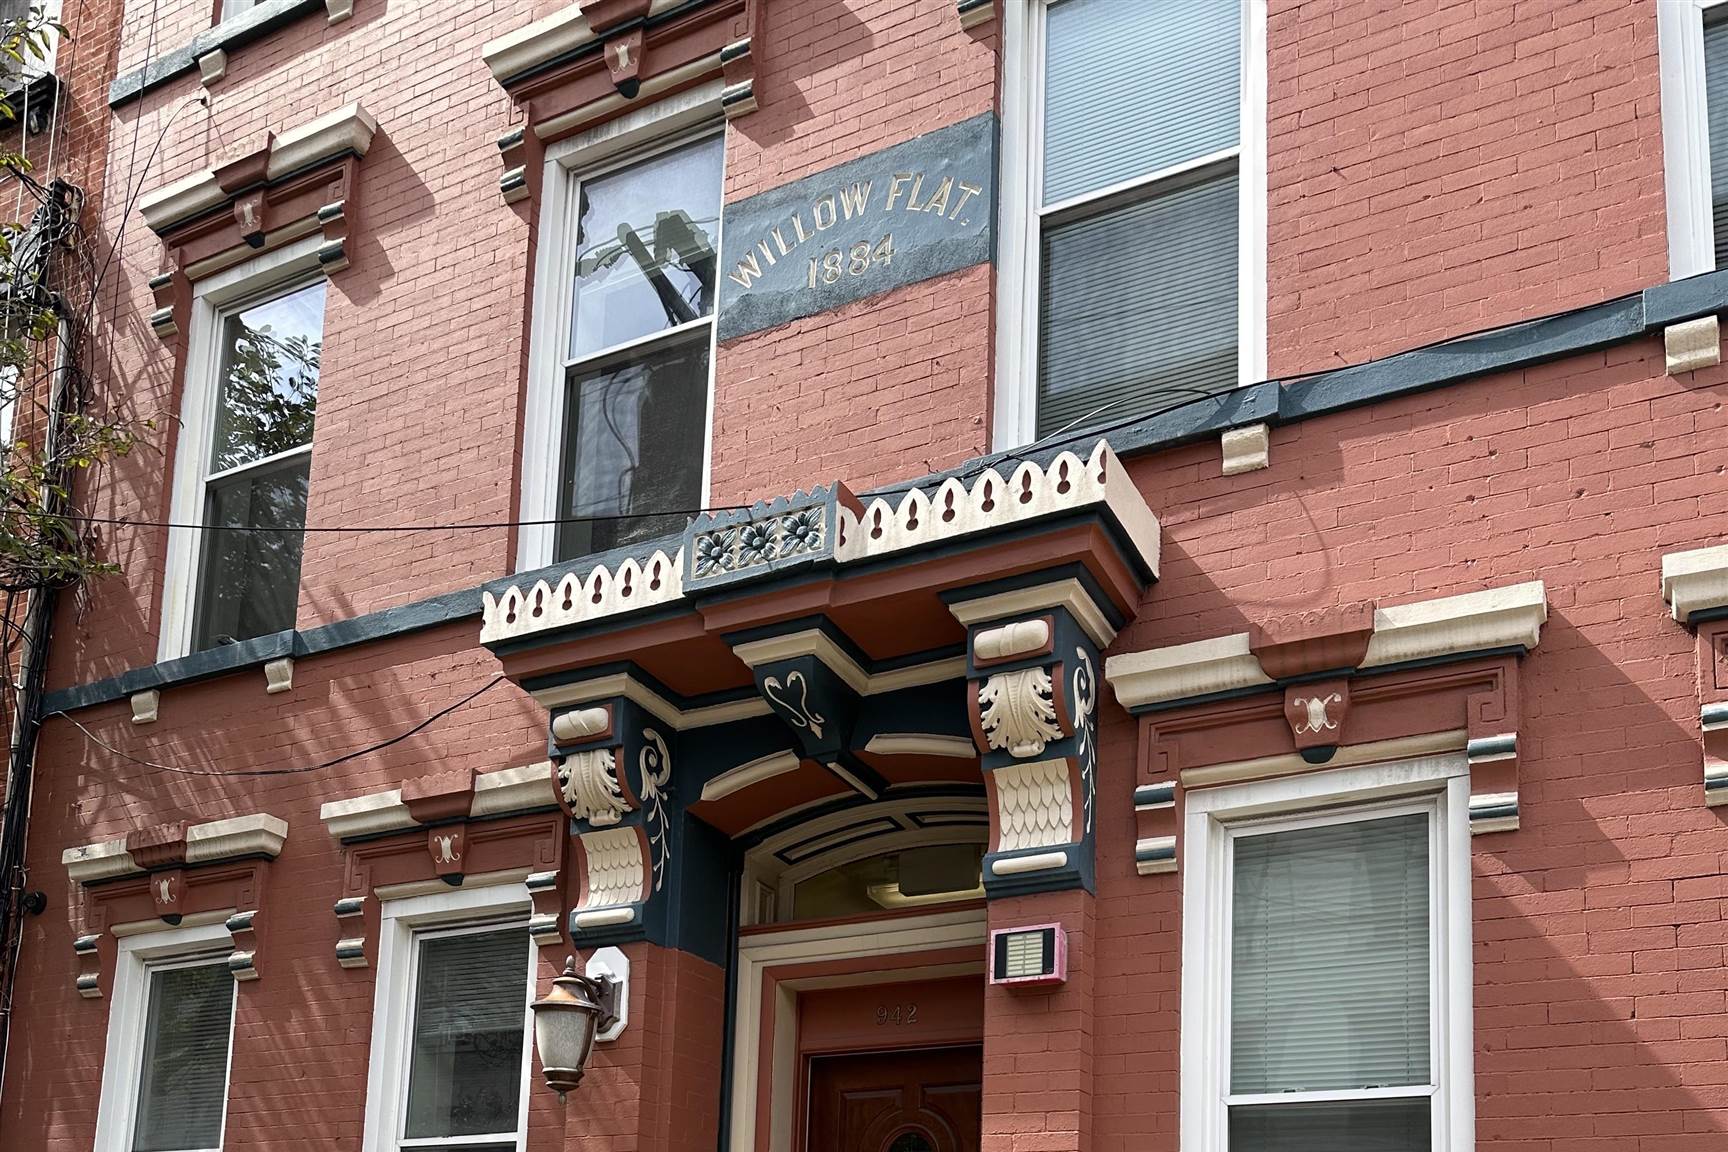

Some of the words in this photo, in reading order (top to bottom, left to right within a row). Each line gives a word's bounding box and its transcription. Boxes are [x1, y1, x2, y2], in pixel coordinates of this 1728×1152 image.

[729, 181, 872, 288] WILLOW
[807, 233, 895, 289] 1884
[877, 1005, 917, 1025] 942
